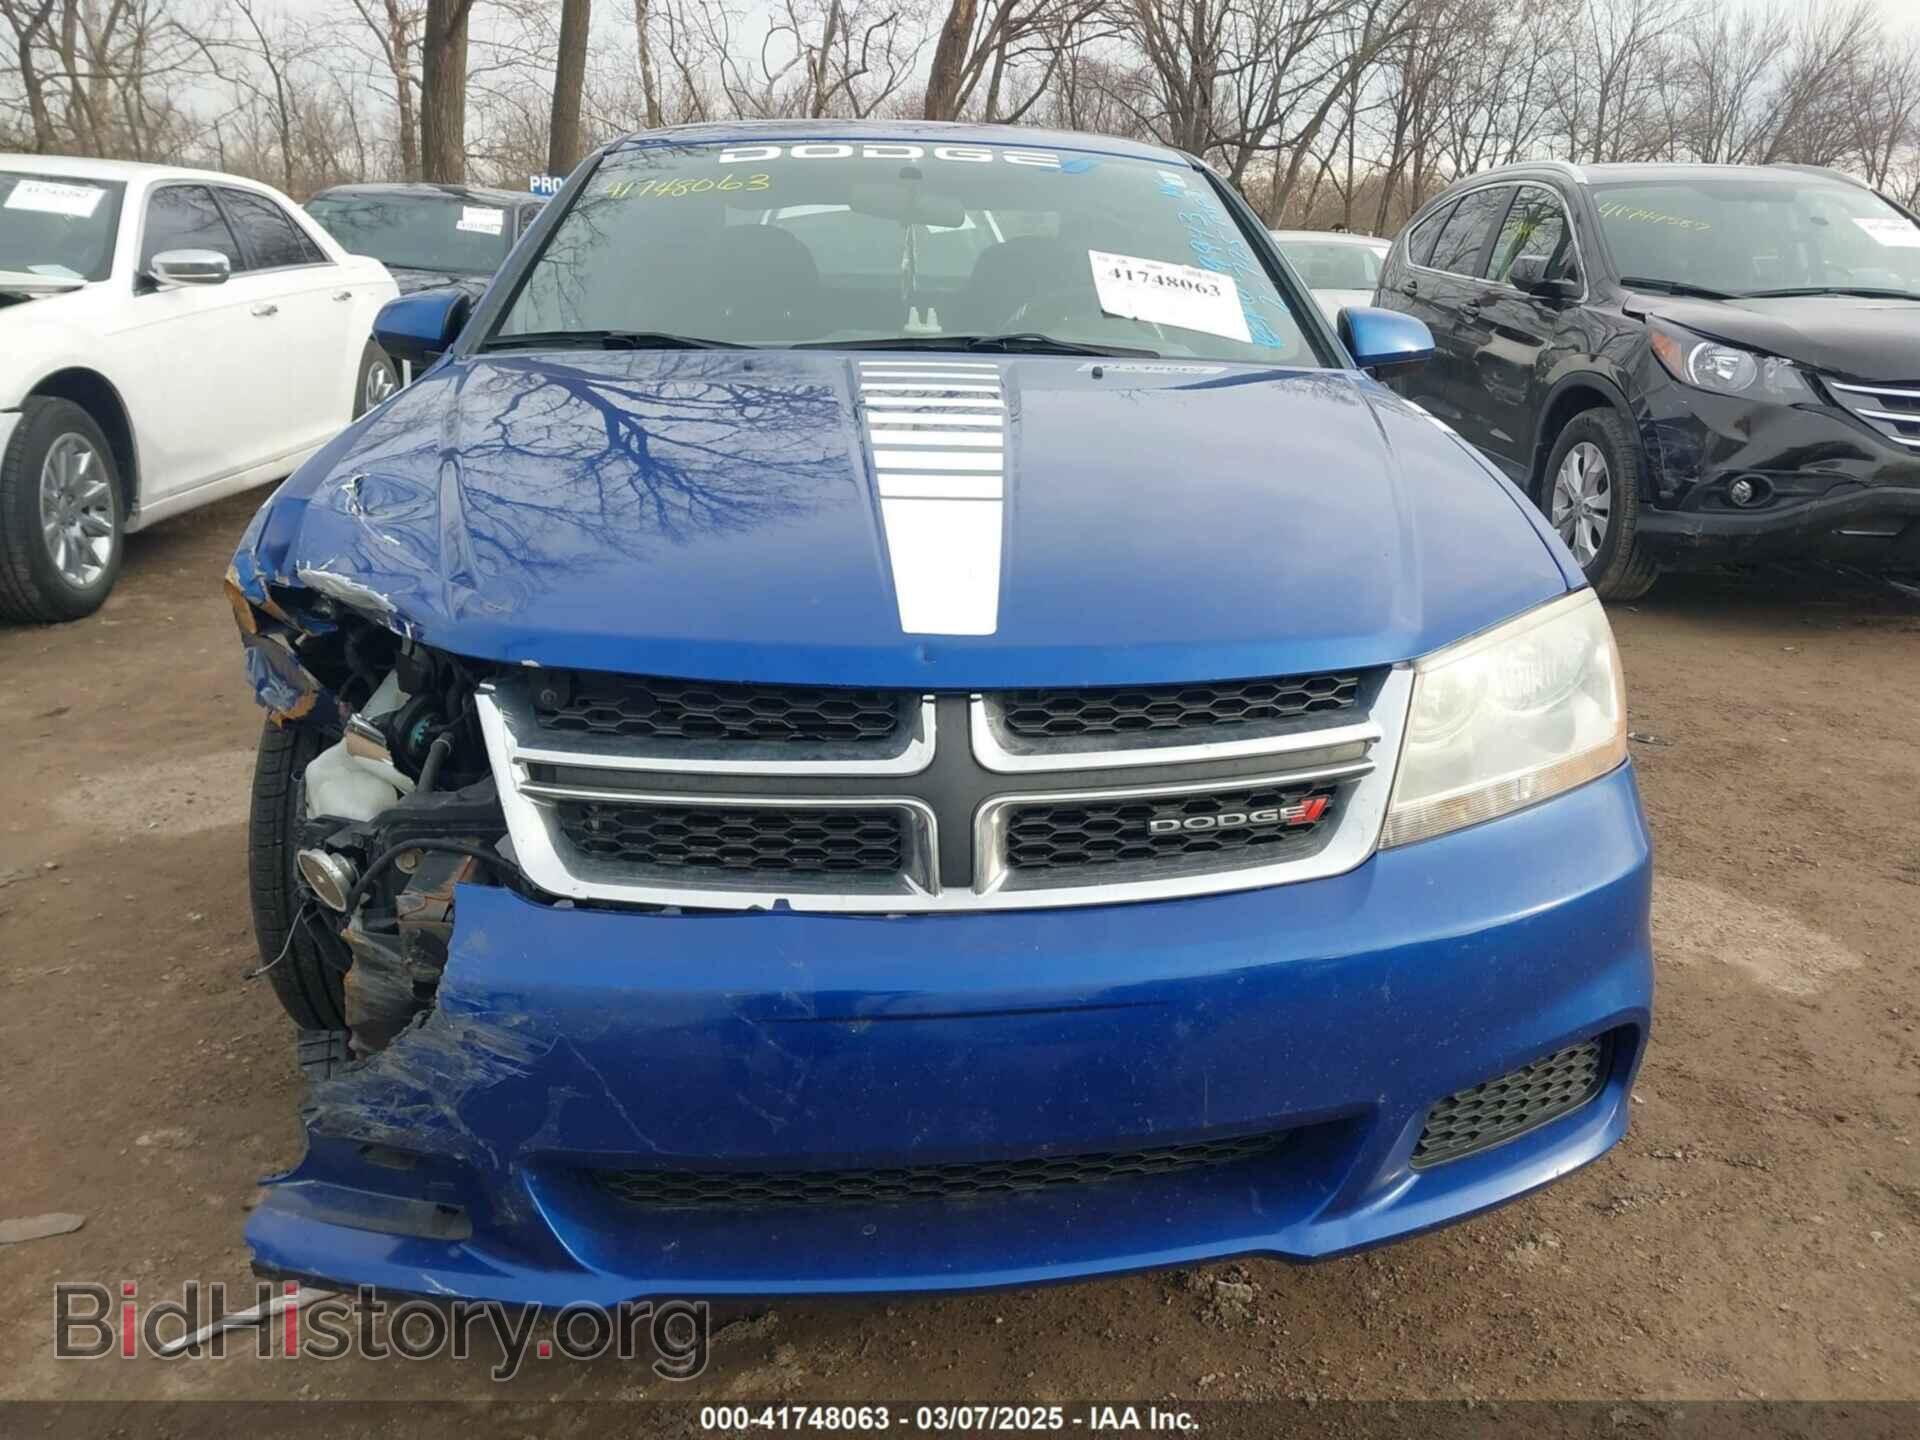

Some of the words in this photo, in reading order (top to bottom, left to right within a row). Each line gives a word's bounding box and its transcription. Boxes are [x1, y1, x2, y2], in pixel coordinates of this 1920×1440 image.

[718, 144, 1062, 168] DODGE
[609, 174, 770, 198] 41748063
[1109, 267, 1221, 297] 41748063
[1150, 805, 1306, 832] DODGE
